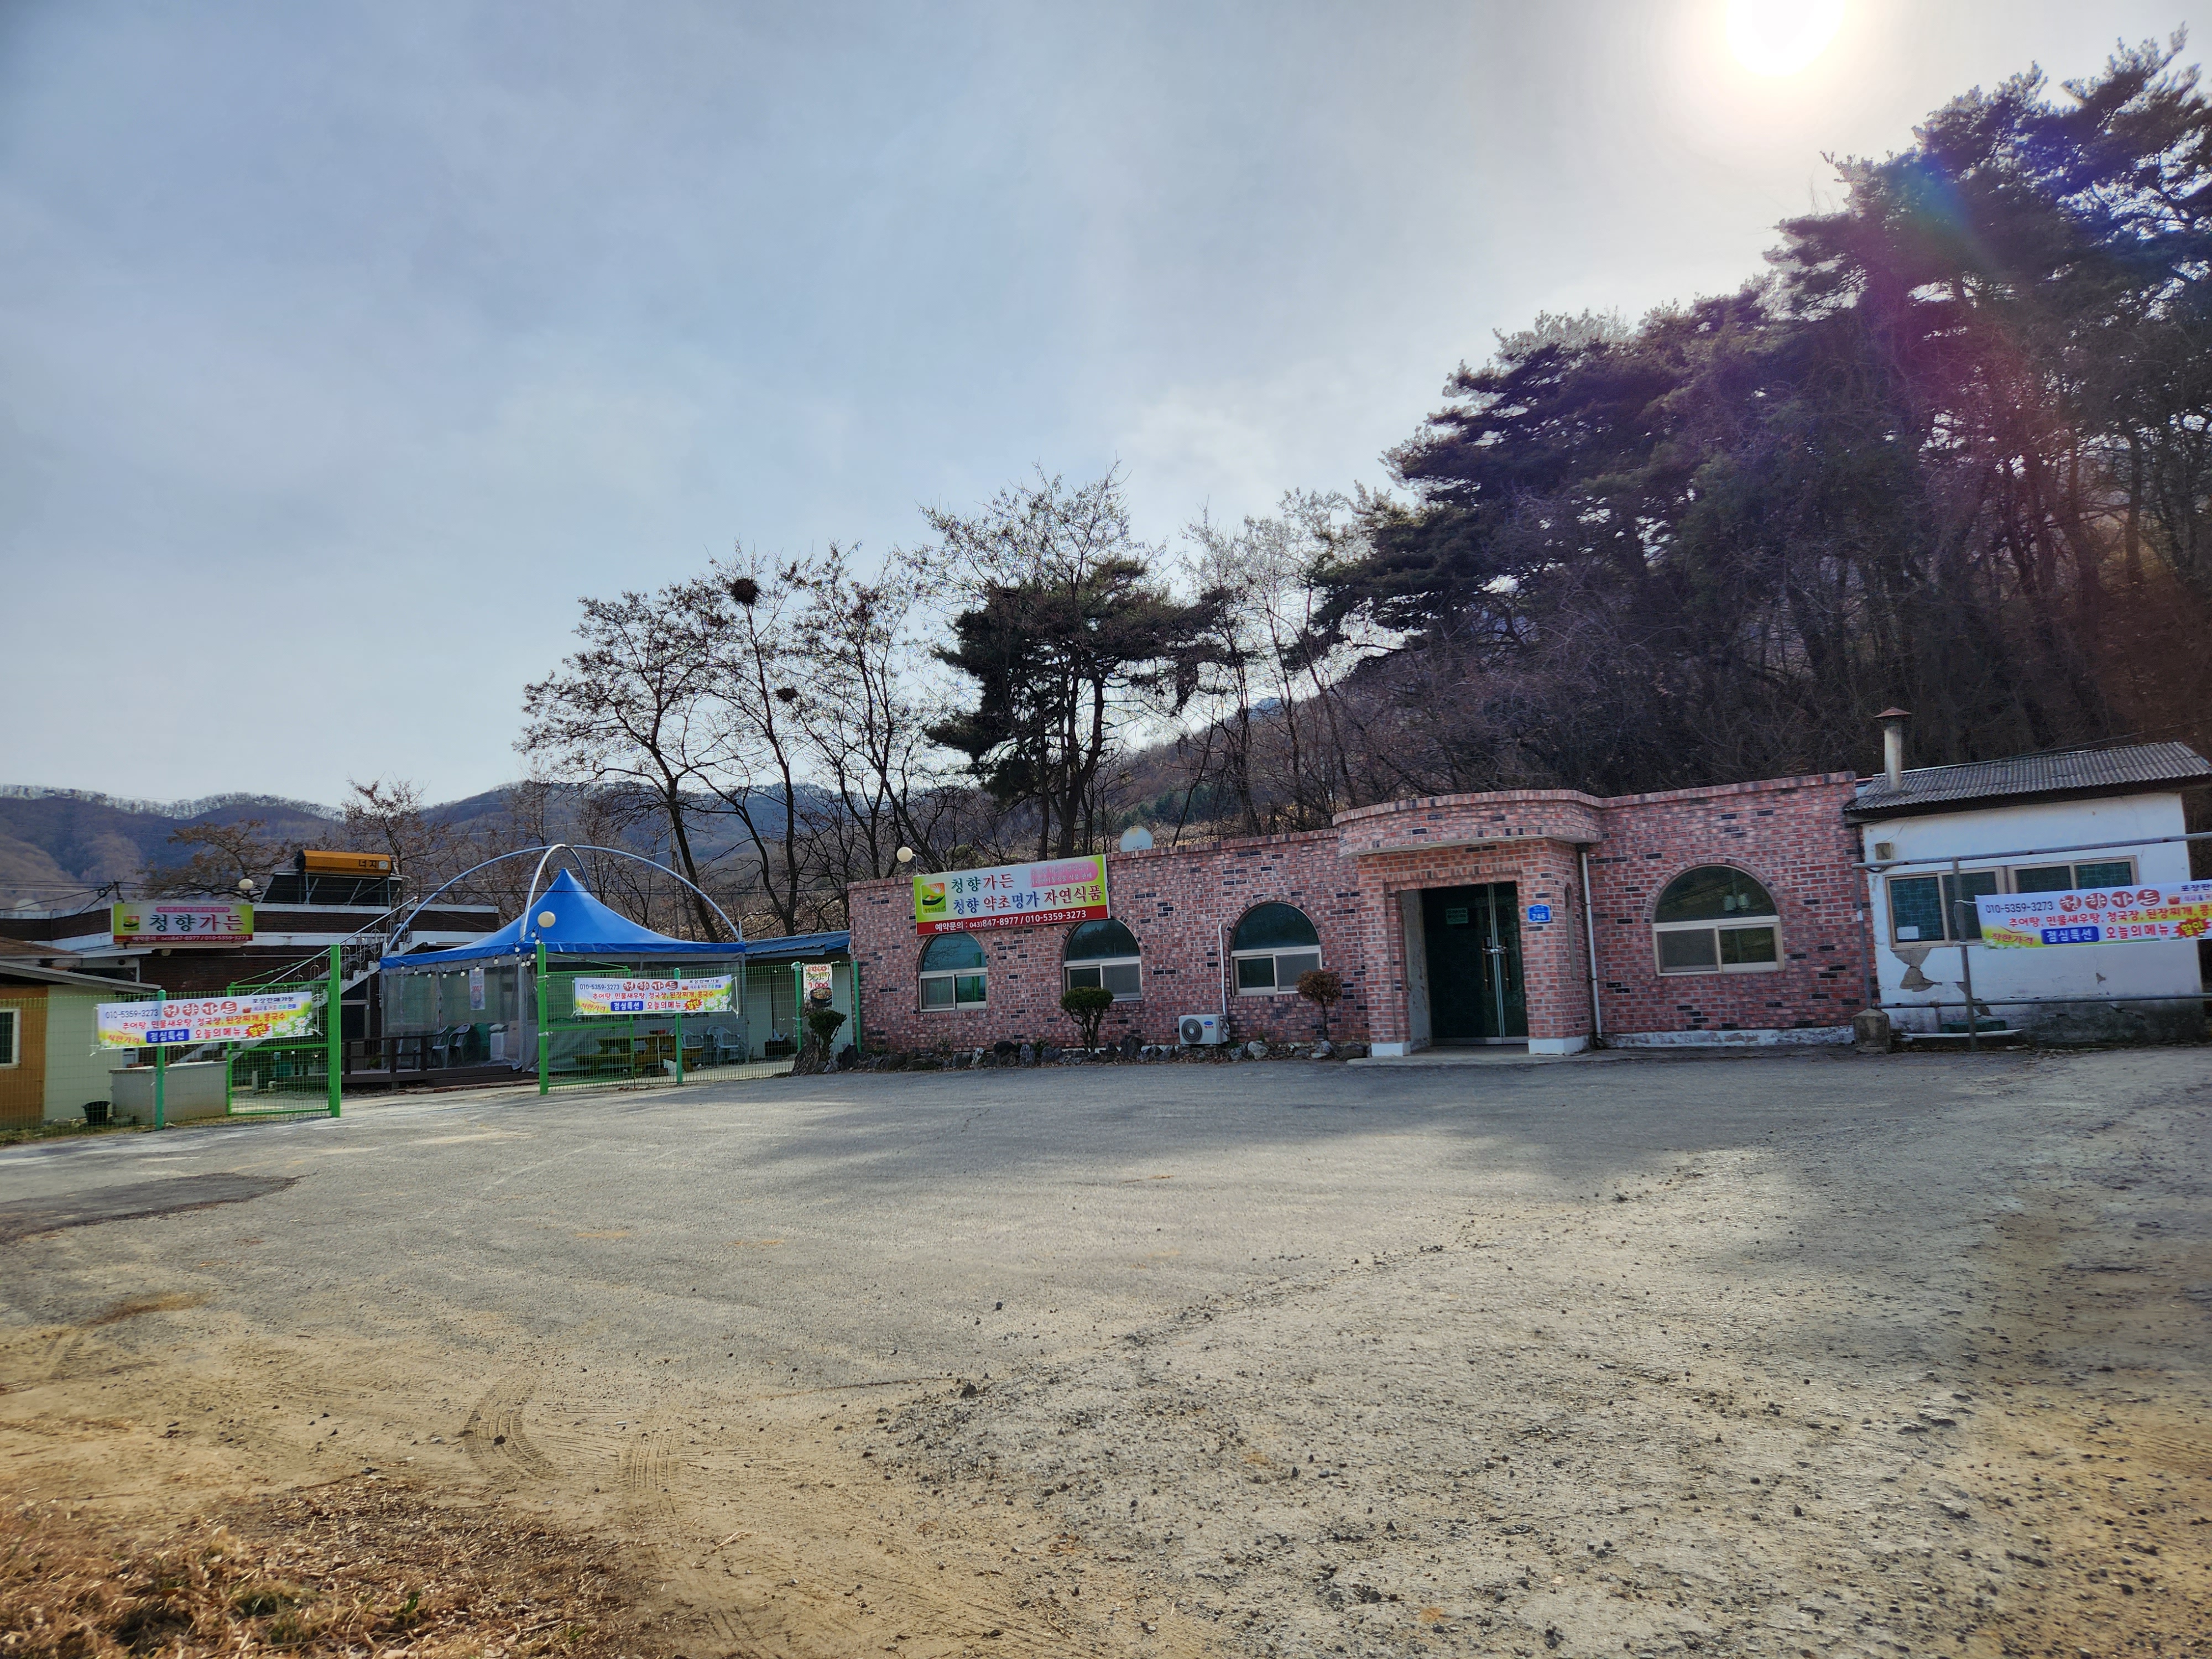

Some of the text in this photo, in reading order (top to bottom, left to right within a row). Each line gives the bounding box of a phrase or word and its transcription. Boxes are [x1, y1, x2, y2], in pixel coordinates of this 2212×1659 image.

[951, 874, 1014, 893] 청향가든
[2181, 883, 2212, 892] 포장판
[953, 885, 1103, 915] 청향 약초명가 자연식품
[2060, 889, 2159, 912] 청향가든
[1986, 901, 2053, 913] 010-5359-3273
[2200, 904, 2212, 916] 콩
[149, 914, 246, 932] 청향가든
[935, 921, 964, 932] 예약문의
[969, 917, 1019, 928] 043)847-8977
[1025, 910, 1087, 923] 010-5359-3273
[2180, 921, 2206, 936] 할인
[1992, 932, 2033, 945] 착한가격
[2047, 928, 2092, 942] 점심특선
[623, 980, 679, 992] 청향가든
[164, 1001, 237, 1018] 청향가든
[613, 1001, 640, 1010] 점심특선
[687, 1000, 700, 1010] 할인
[106, 1009, 159, 1019] 010-5359-3273
[264, 1013, 286, 1022] 콩국수
[150, 1031, 185, 1042] 점심특선
[249, 1025, 267, 1037] 할인
